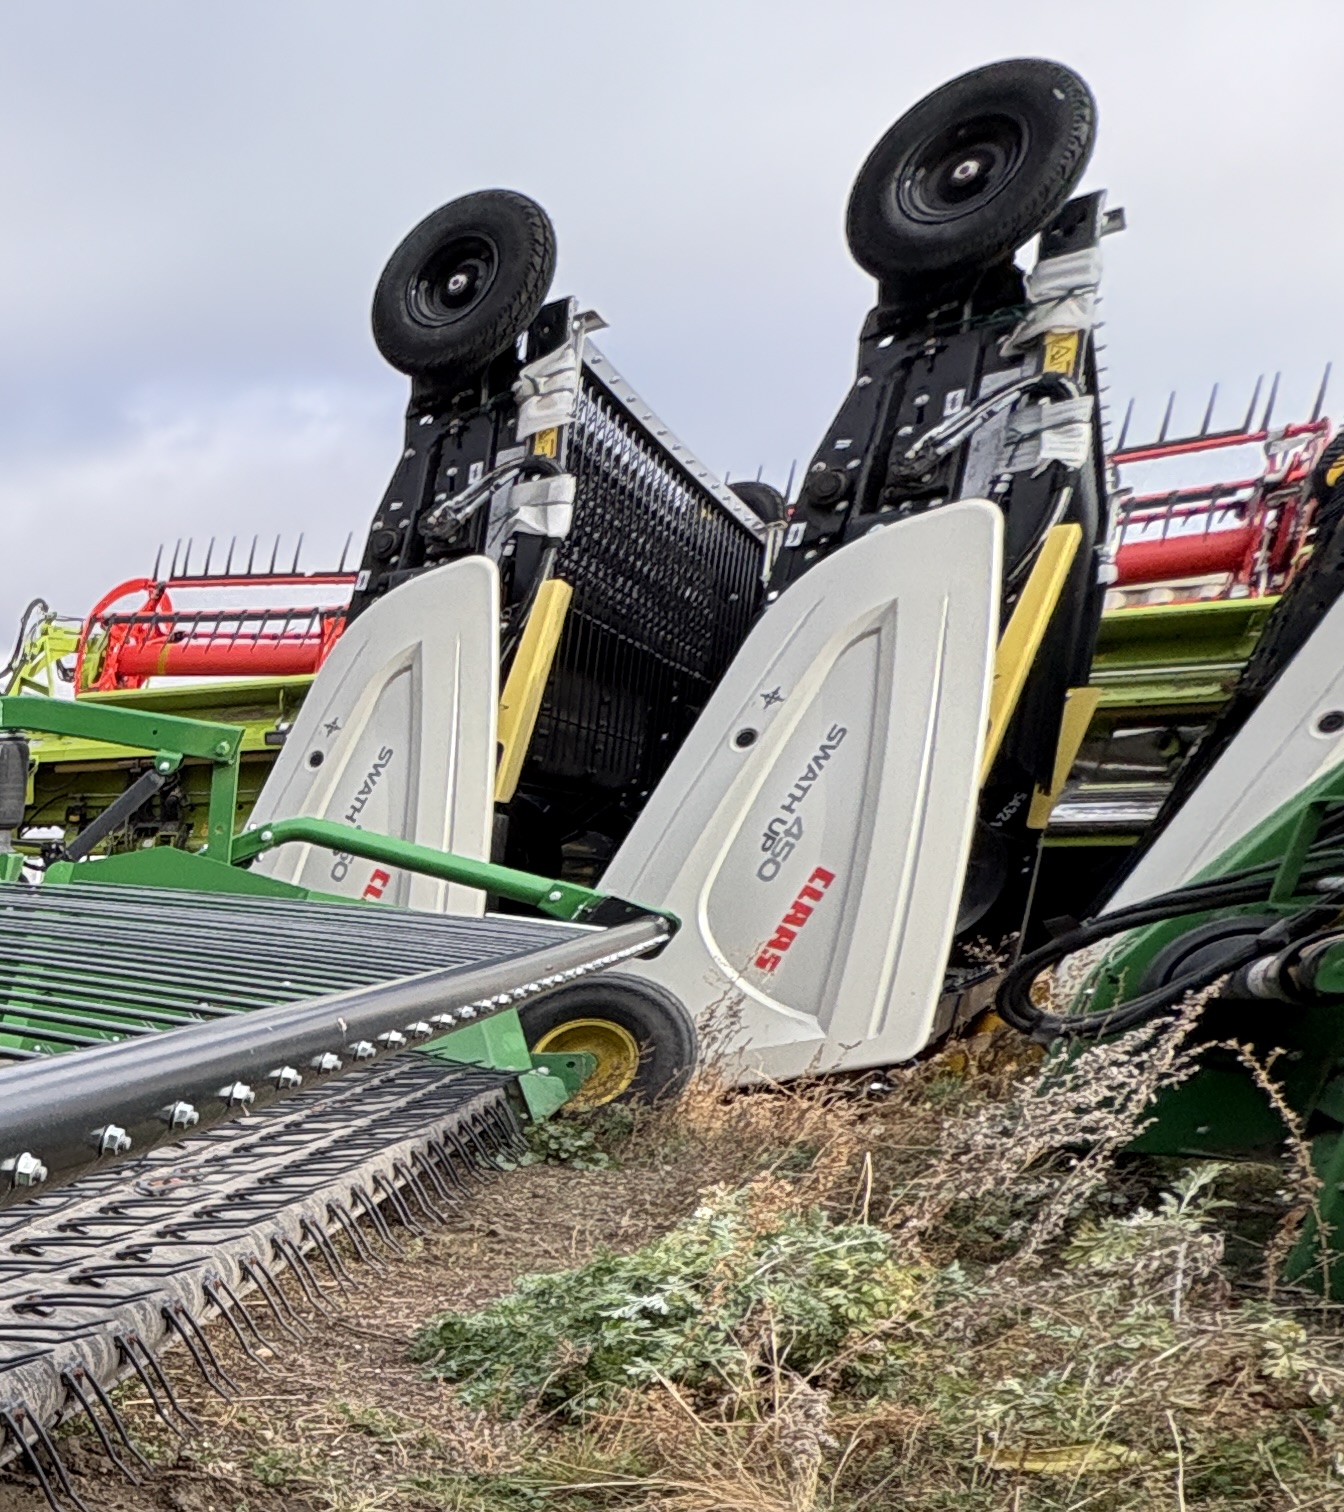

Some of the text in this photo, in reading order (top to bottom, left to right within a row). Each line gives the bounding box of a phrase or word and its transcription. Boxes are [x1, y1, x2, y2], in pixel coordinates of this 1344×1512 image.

[345, 746, 394, 823] SWATH
[760, 723, 848, 852] SWATH UP
[756, 816, 804, 882] 450
[754, 866, 836, 973] CLAAS
